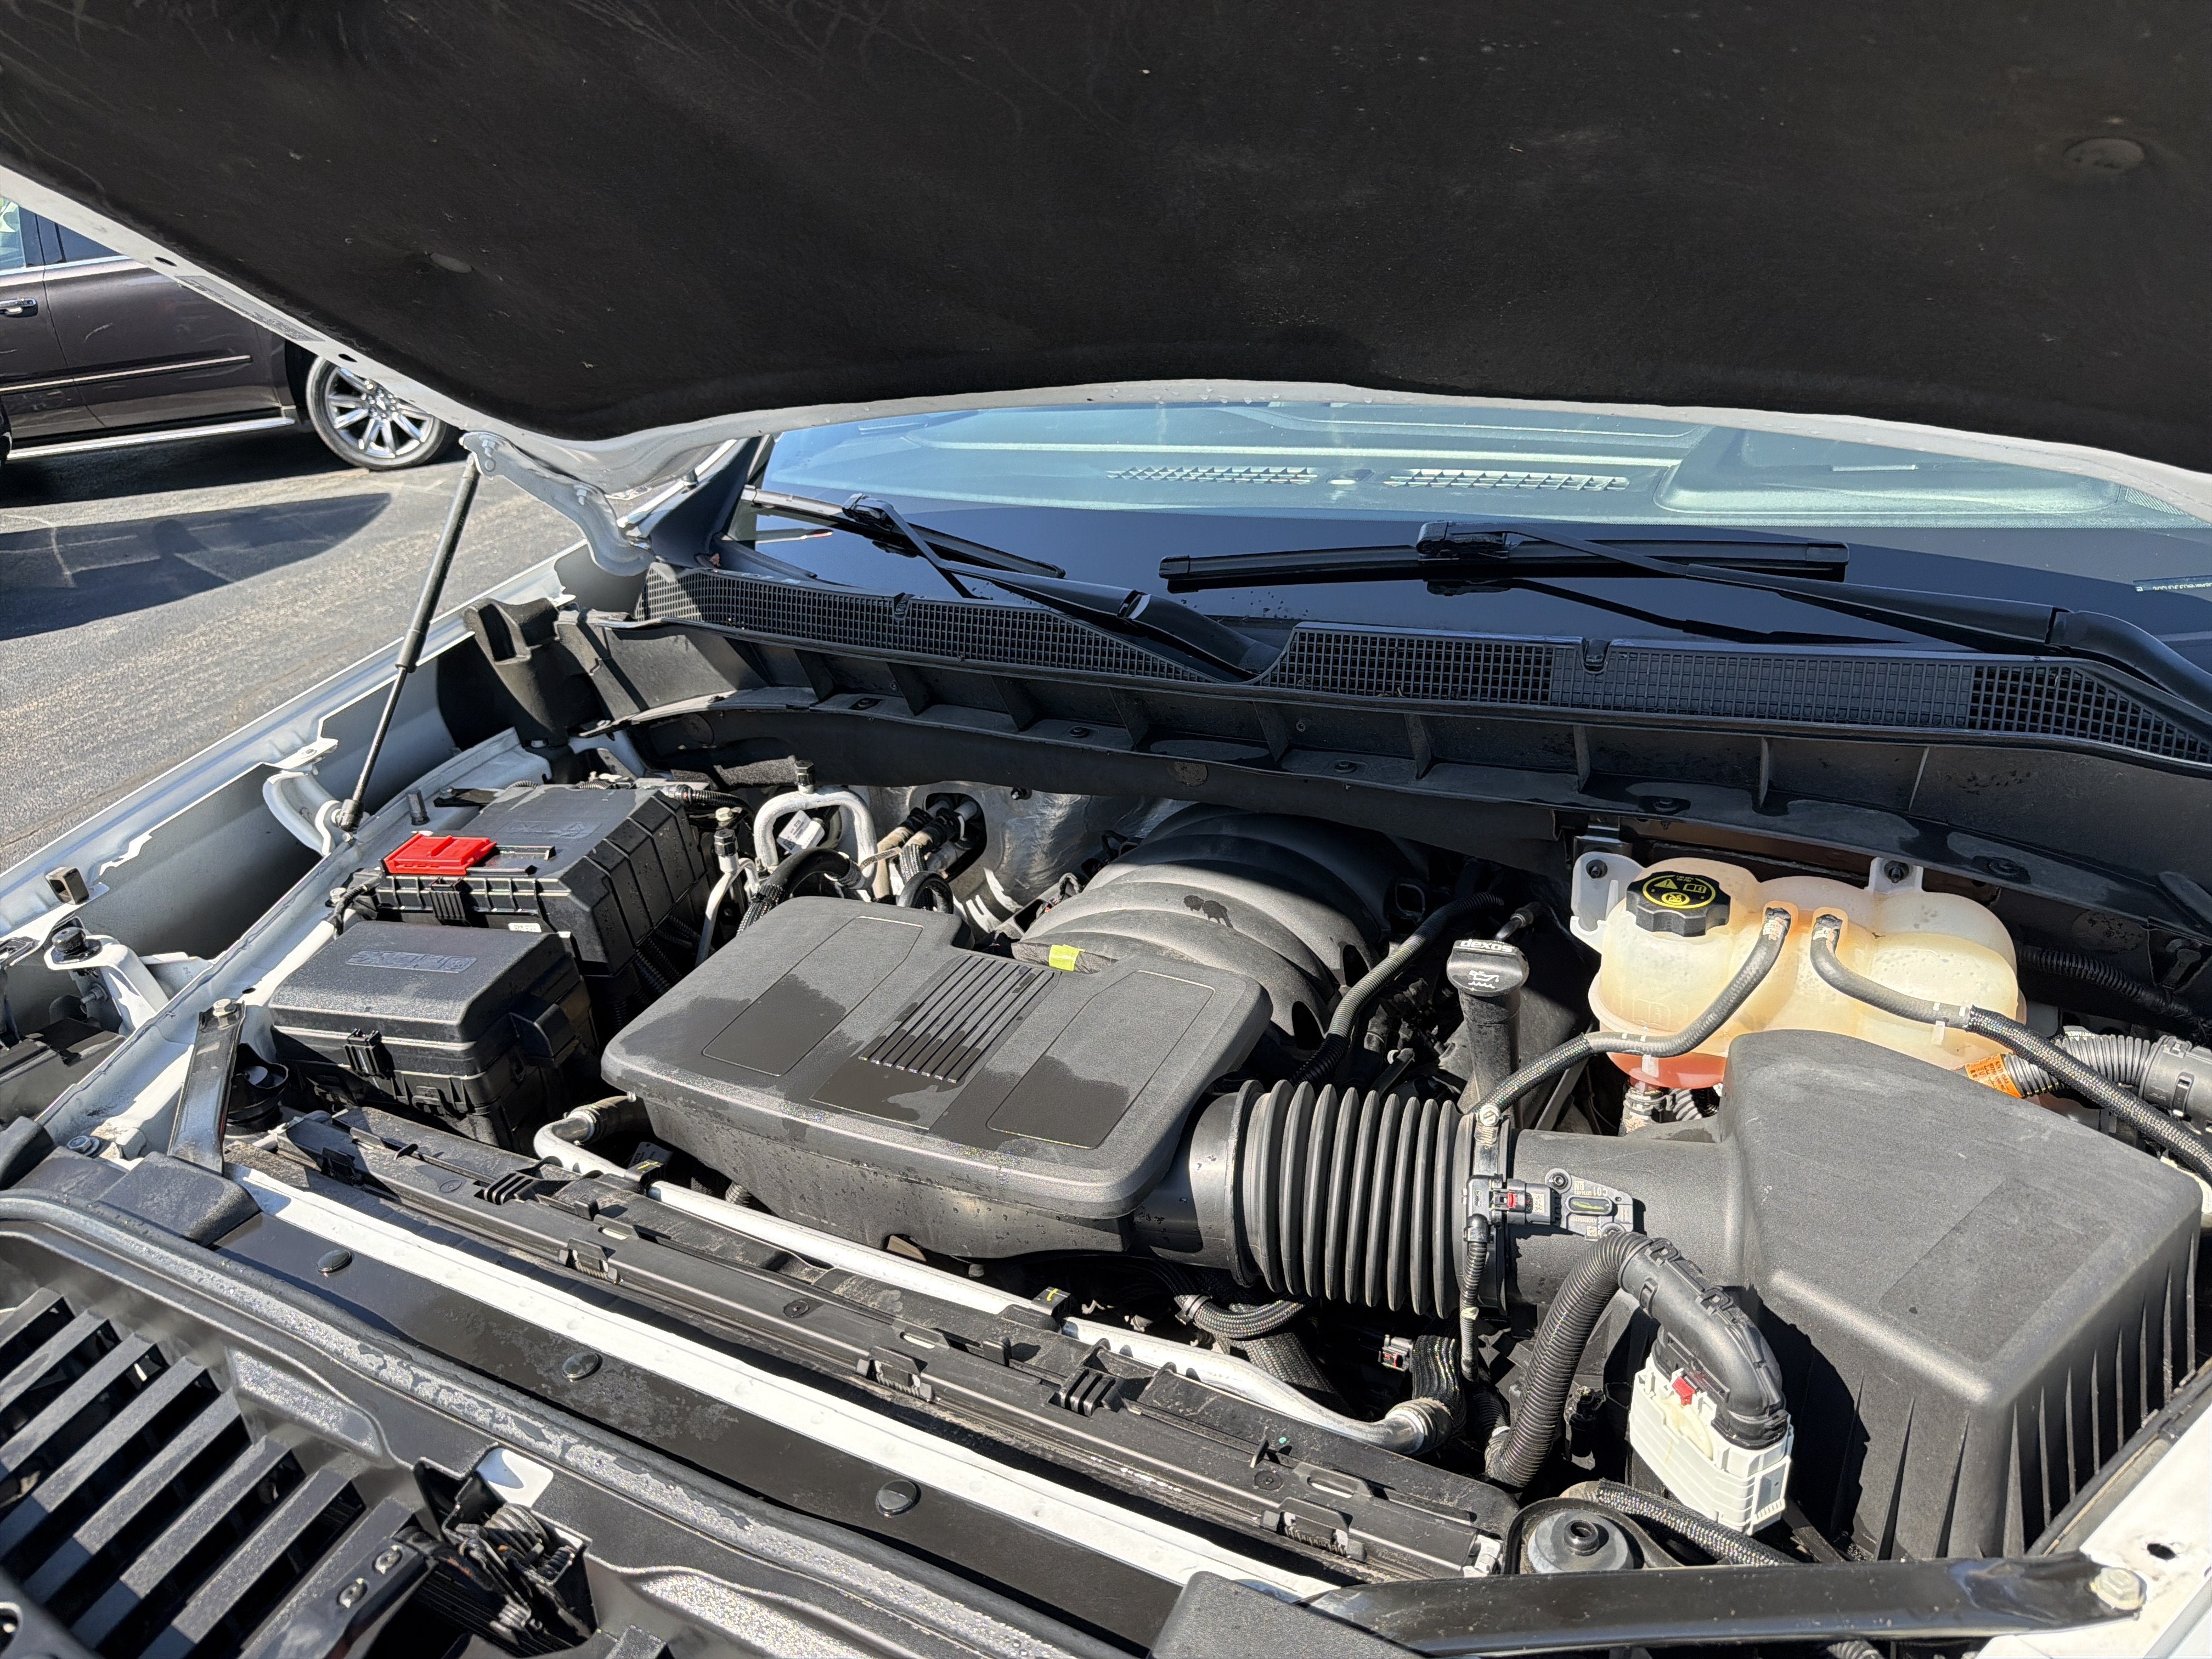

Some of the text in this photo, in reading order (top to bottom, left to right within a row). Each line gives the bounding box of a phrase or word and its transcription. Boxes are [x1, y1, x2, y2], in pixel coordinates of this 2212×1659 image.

[1460, 939, 1515, 953] dexos
[1574, 1182, 1584, 1191] GM
[1593, 1186, 1608, 1197] C01
